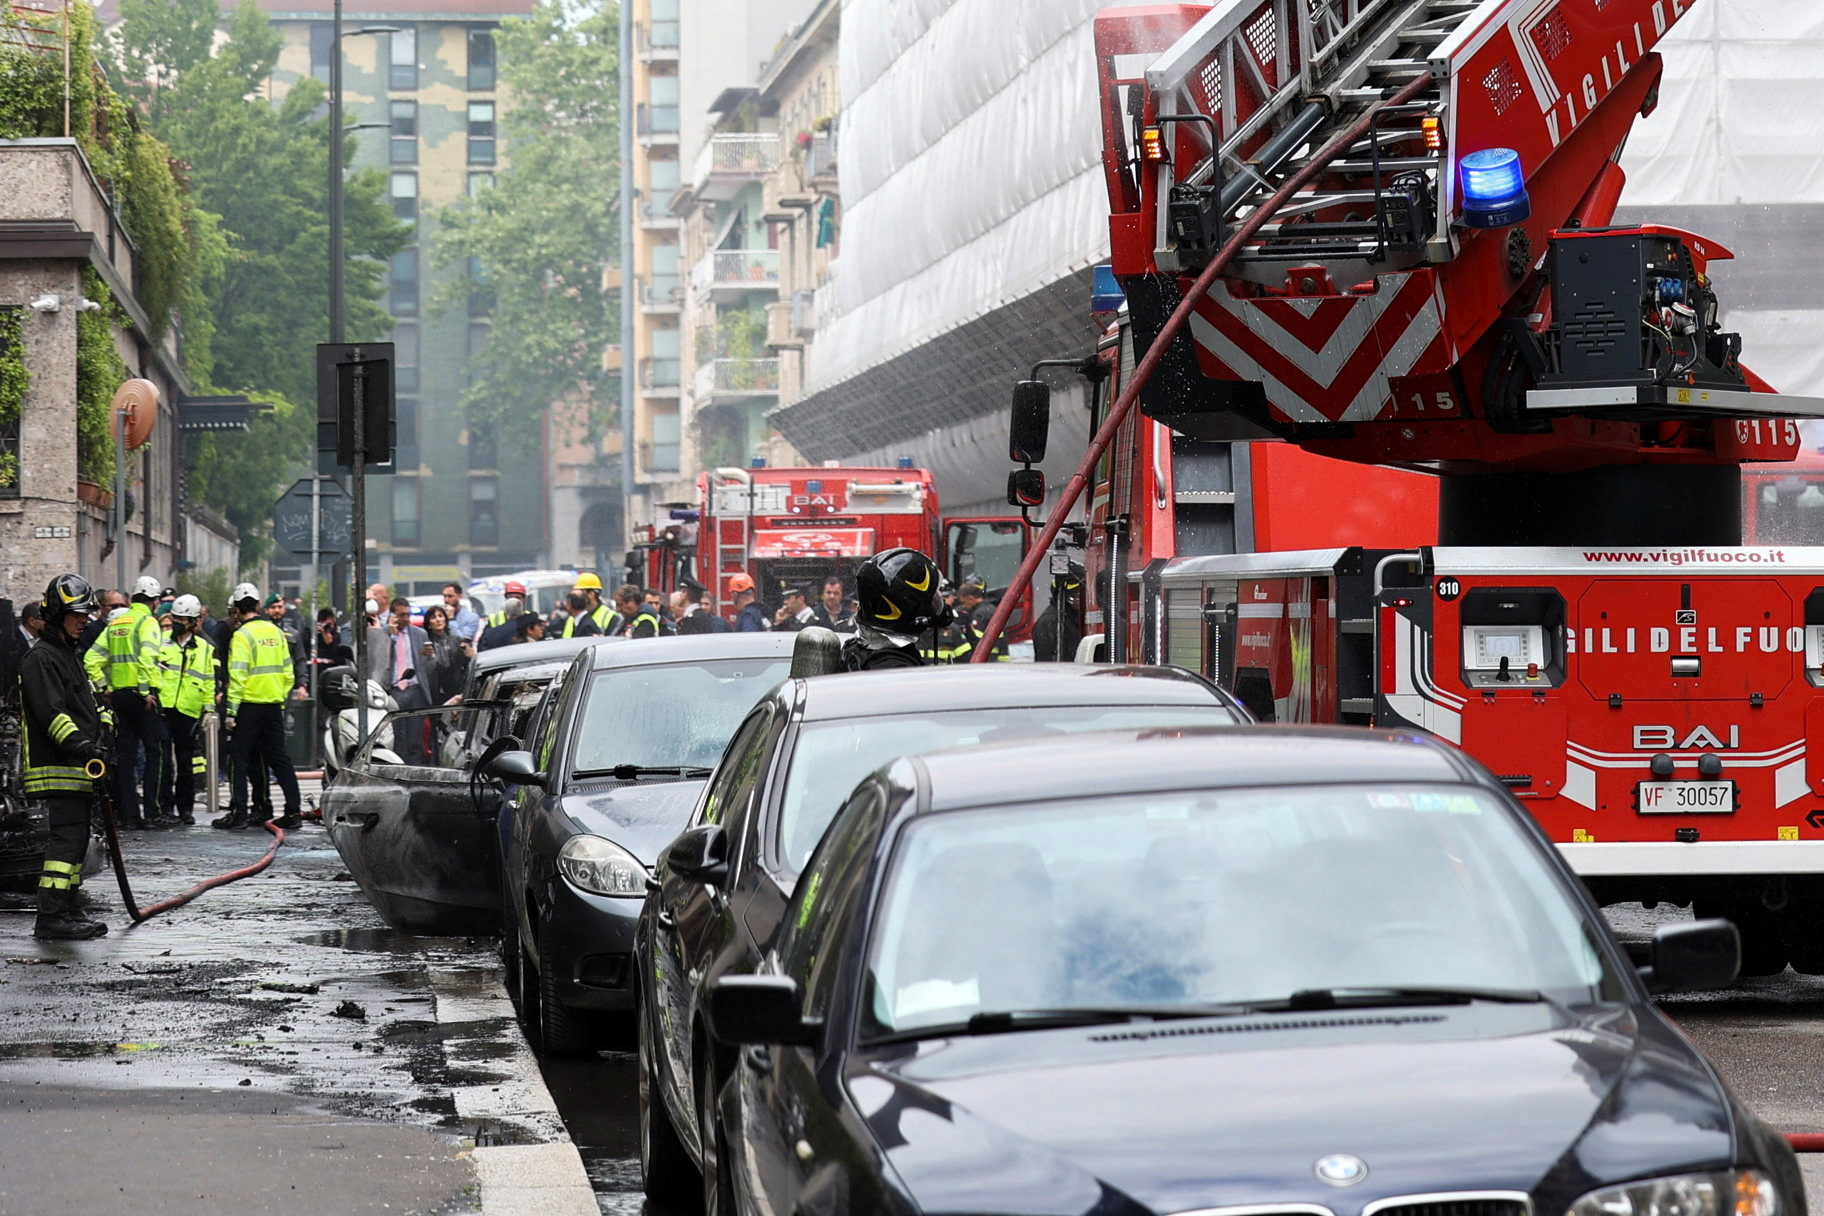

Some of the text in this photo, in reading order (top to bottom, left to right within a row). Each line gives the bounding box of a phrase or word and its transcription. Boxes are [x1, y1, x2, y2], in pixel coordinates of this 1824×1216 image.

[1545, 22, 1645, 148] VIGILI
[794, 496, 834, 505] BAI
[1583, 549, 1786, 566] www.vigilfuoco.it
[1439, 582, 1459, 595] 310
[1650, 627, 1724, 653] DEL
[1633, 725, 1739, 749] BAI
[1645, 787, 1729, 807] VF 30057
